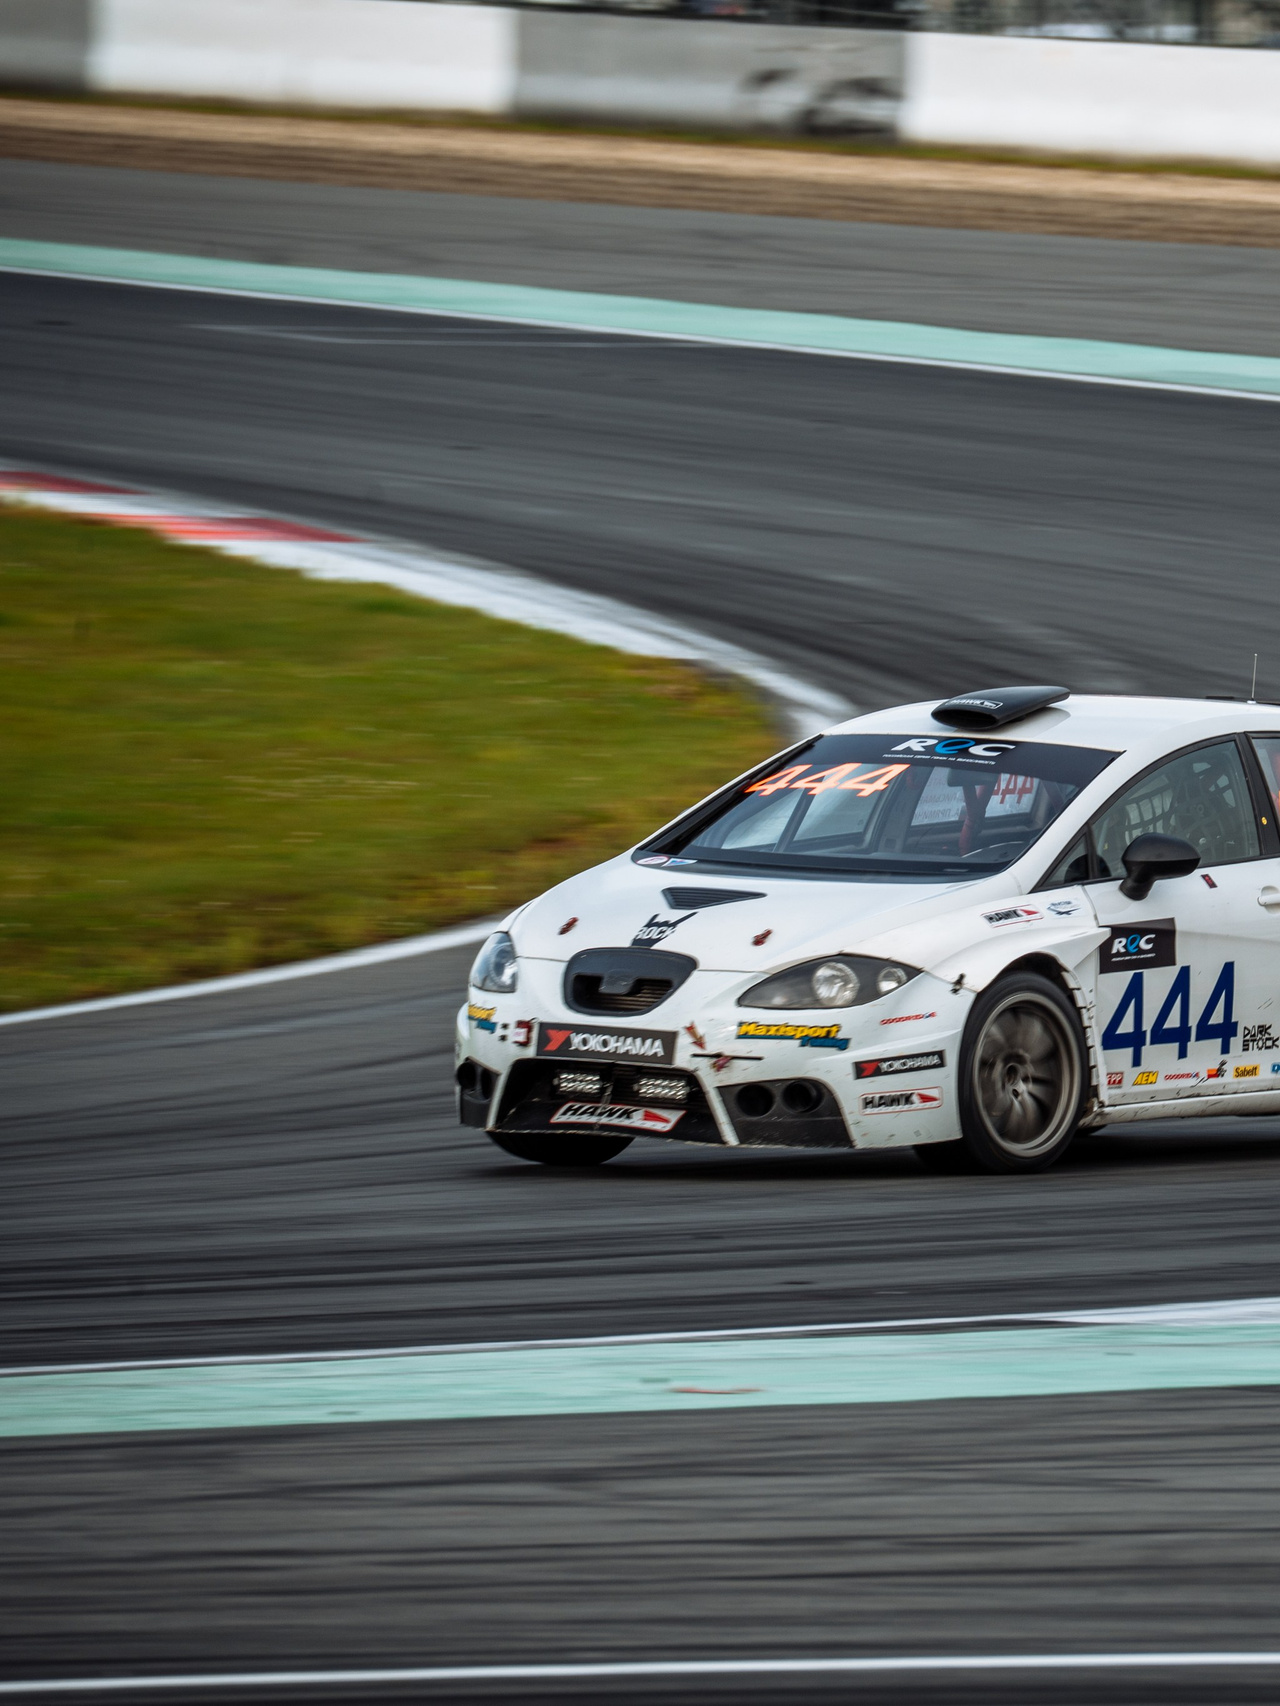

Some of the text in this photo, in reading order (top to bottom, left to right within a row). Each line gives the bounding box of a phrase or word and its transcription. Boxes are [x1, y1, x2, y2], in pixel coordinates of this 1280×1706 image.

[744, 762, 911, 797] 444
[1101, 961, 1239, 1068] 444
[737, 1021, 842, 1040] Maxisport
[1243, 1024, 1273, 1039] DARK
[568, 1032, 665, 1057] YOKOHAMA
[1242, 1036, 1280, 1052] STOCK
[878, 1054, 942, 1073] YOKOHAMA
[1234, 1066, 1258, 1078] Sabelt
[862, 1092, 917, 1110] HAWK
[561, 1103, 642, 1120] HAWK
